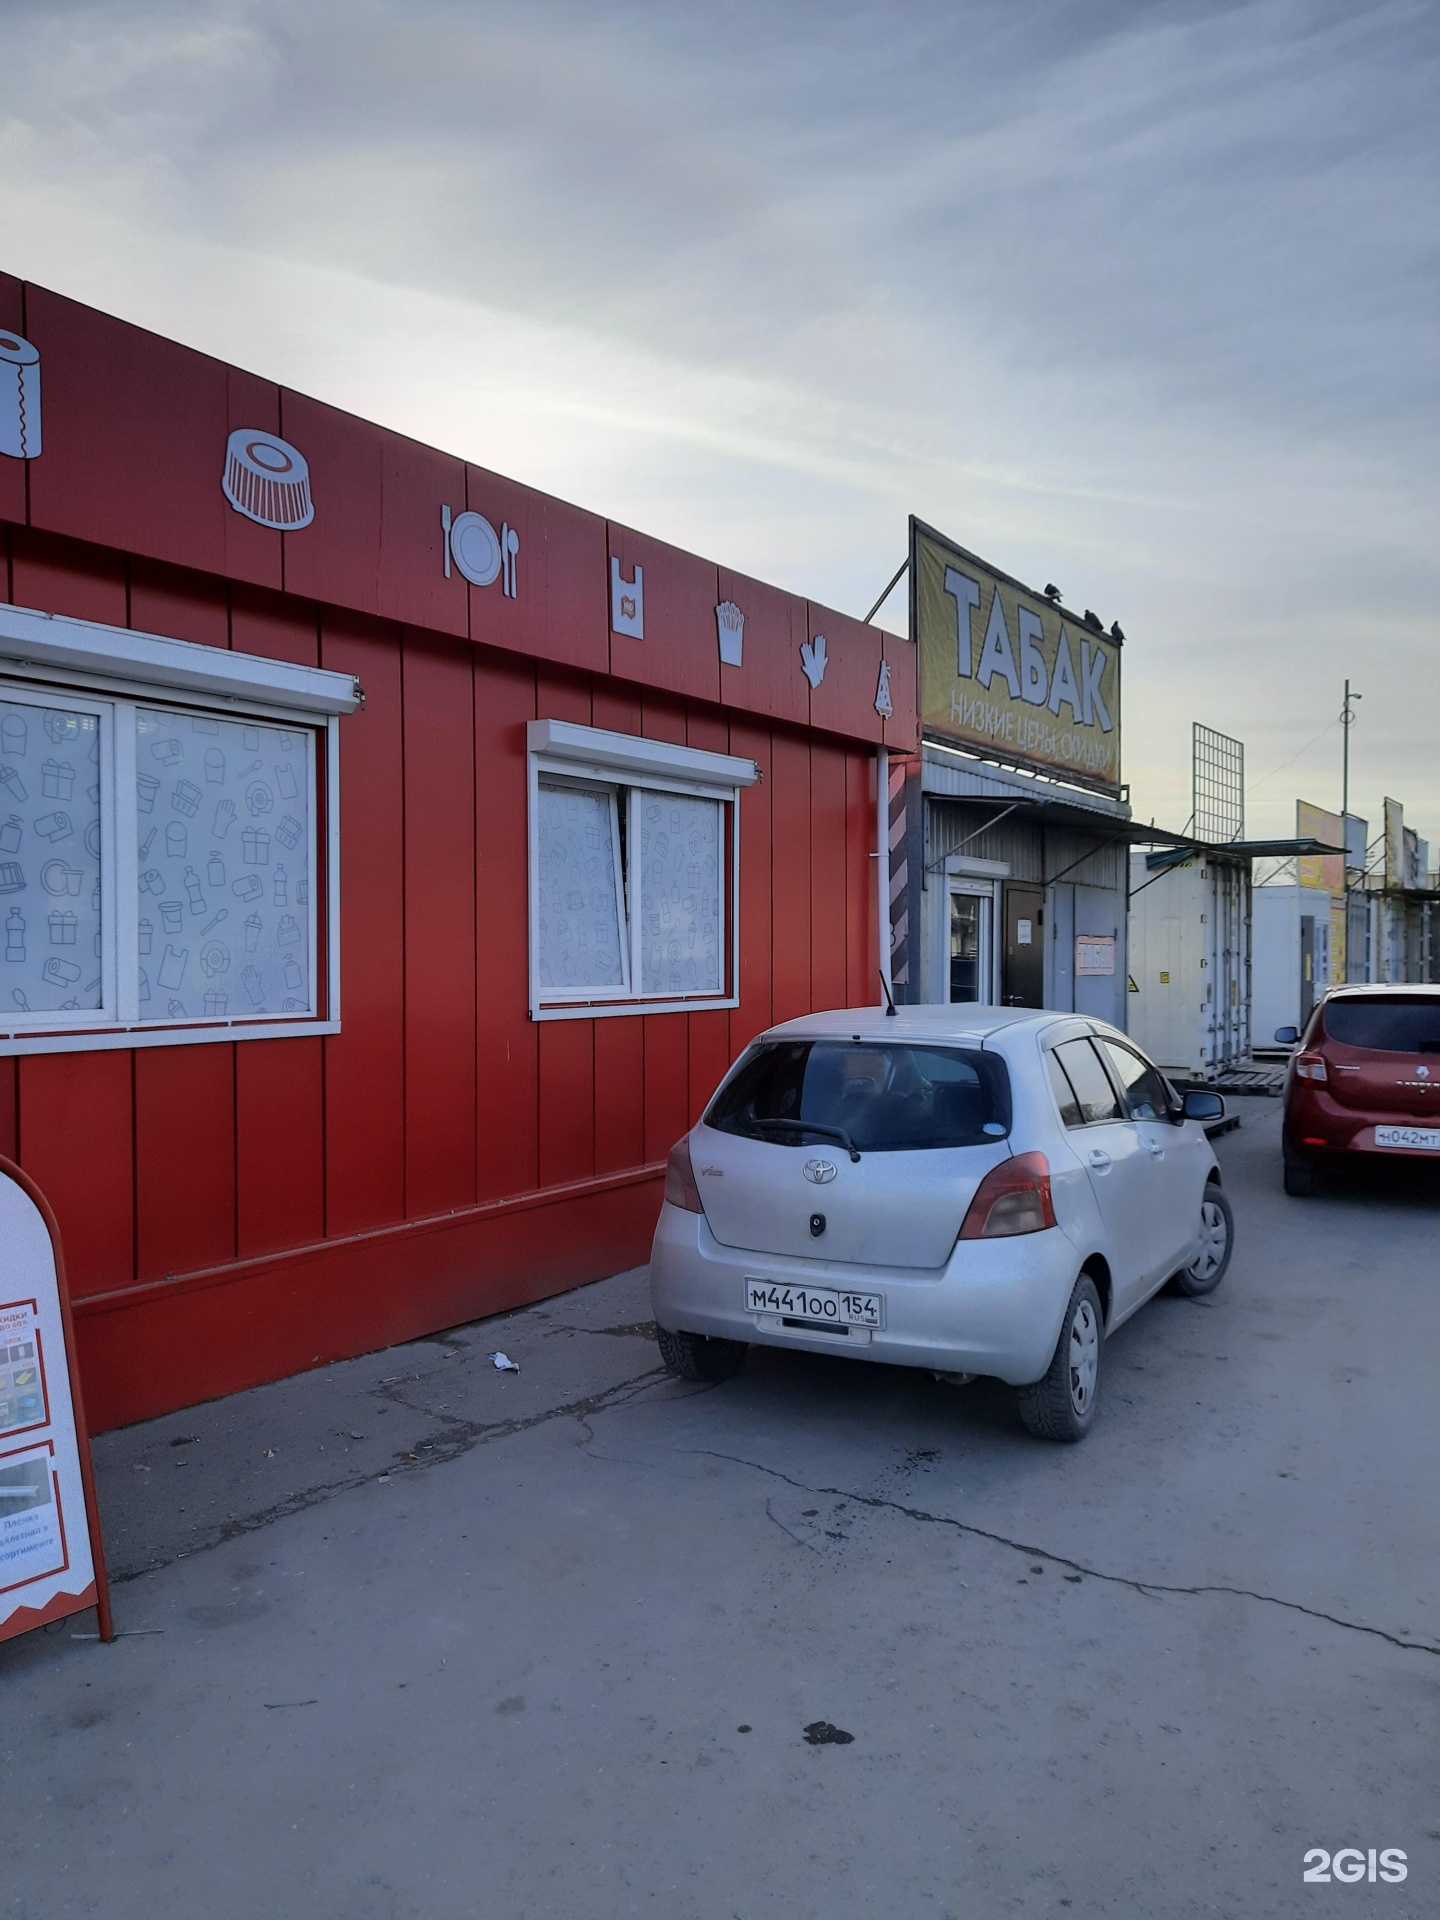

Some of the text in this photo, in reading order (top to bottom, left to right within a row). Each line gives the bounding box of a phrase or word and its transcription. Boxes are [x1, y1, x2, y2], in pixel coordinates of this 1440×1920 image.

[943, 564, 1113, 733] ТАБАК
[951, 690, 1014, 742] НИЗКИЕ
[842, 1295, 874, 1317] 154
